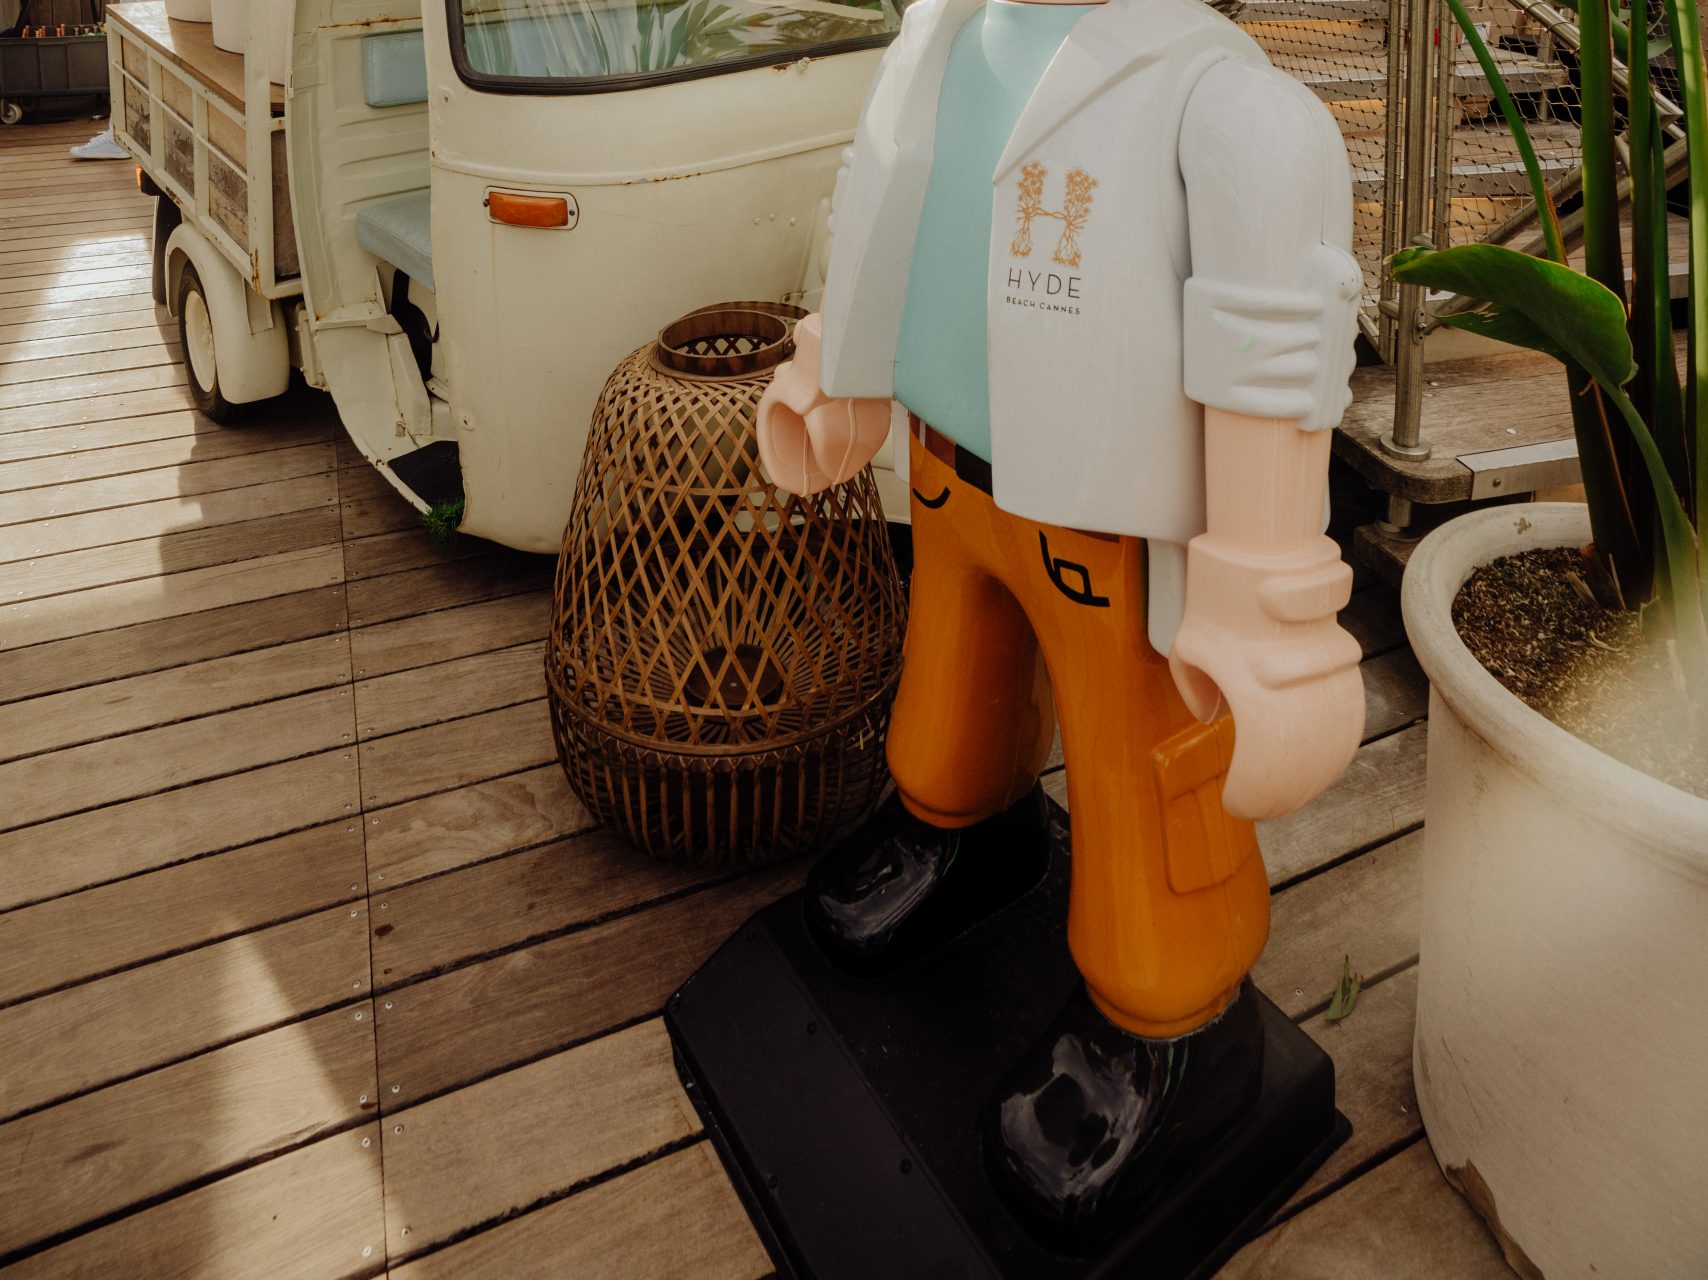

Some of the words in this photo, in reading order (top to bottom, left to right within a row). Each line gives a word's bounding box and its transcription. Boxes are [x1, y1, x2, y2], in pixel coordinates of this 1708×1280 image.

[1007, 267, 1082, 299] HYDE
[1006, 296, 1035, 308] BEACH
[1039, 302, 1081, 315] CANNES
